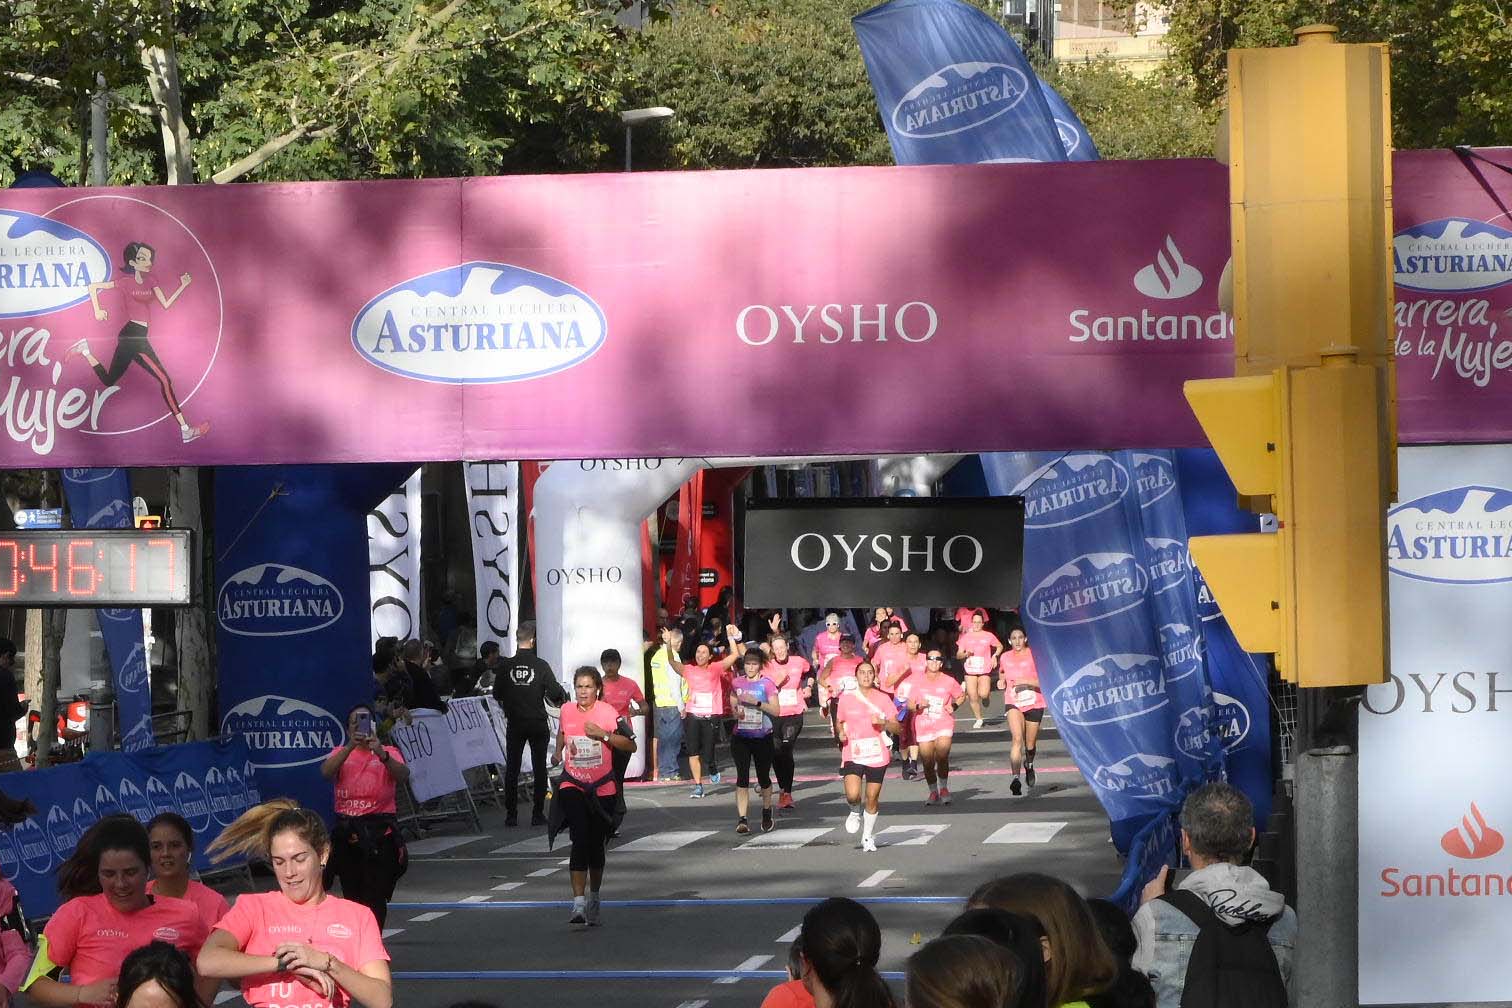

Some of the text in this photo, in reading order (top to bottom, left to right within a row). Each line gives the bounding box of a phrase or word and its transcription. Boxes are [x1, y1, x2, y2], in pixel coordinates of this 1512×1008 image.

[14, 245, 87, 256] LECHERA
[1408, 243, 1460, 252] CENTRAL
[411, 302, 577, 318] CENTRAL LECHERA
[736, 301, 938, 346] OYSHO
[372, 311, 588, 354] ASTURIANA
[1419, 329, 1435, 357] la
[1415, 521, 1483, 531] CENTRAL
[791, 532, 984, 574] OYSHO
[547, 566, 622, 585] OYSHO
[280, 587, 330, 596] LECHERA
[221, 594, 335, 620] ASTURIANA
[516, 670, 528, 679] BP
[280, 719, 330, 728] LECHERA
[396, 721, 432, 762] SHO
[270, 982, 293, 999] TU
